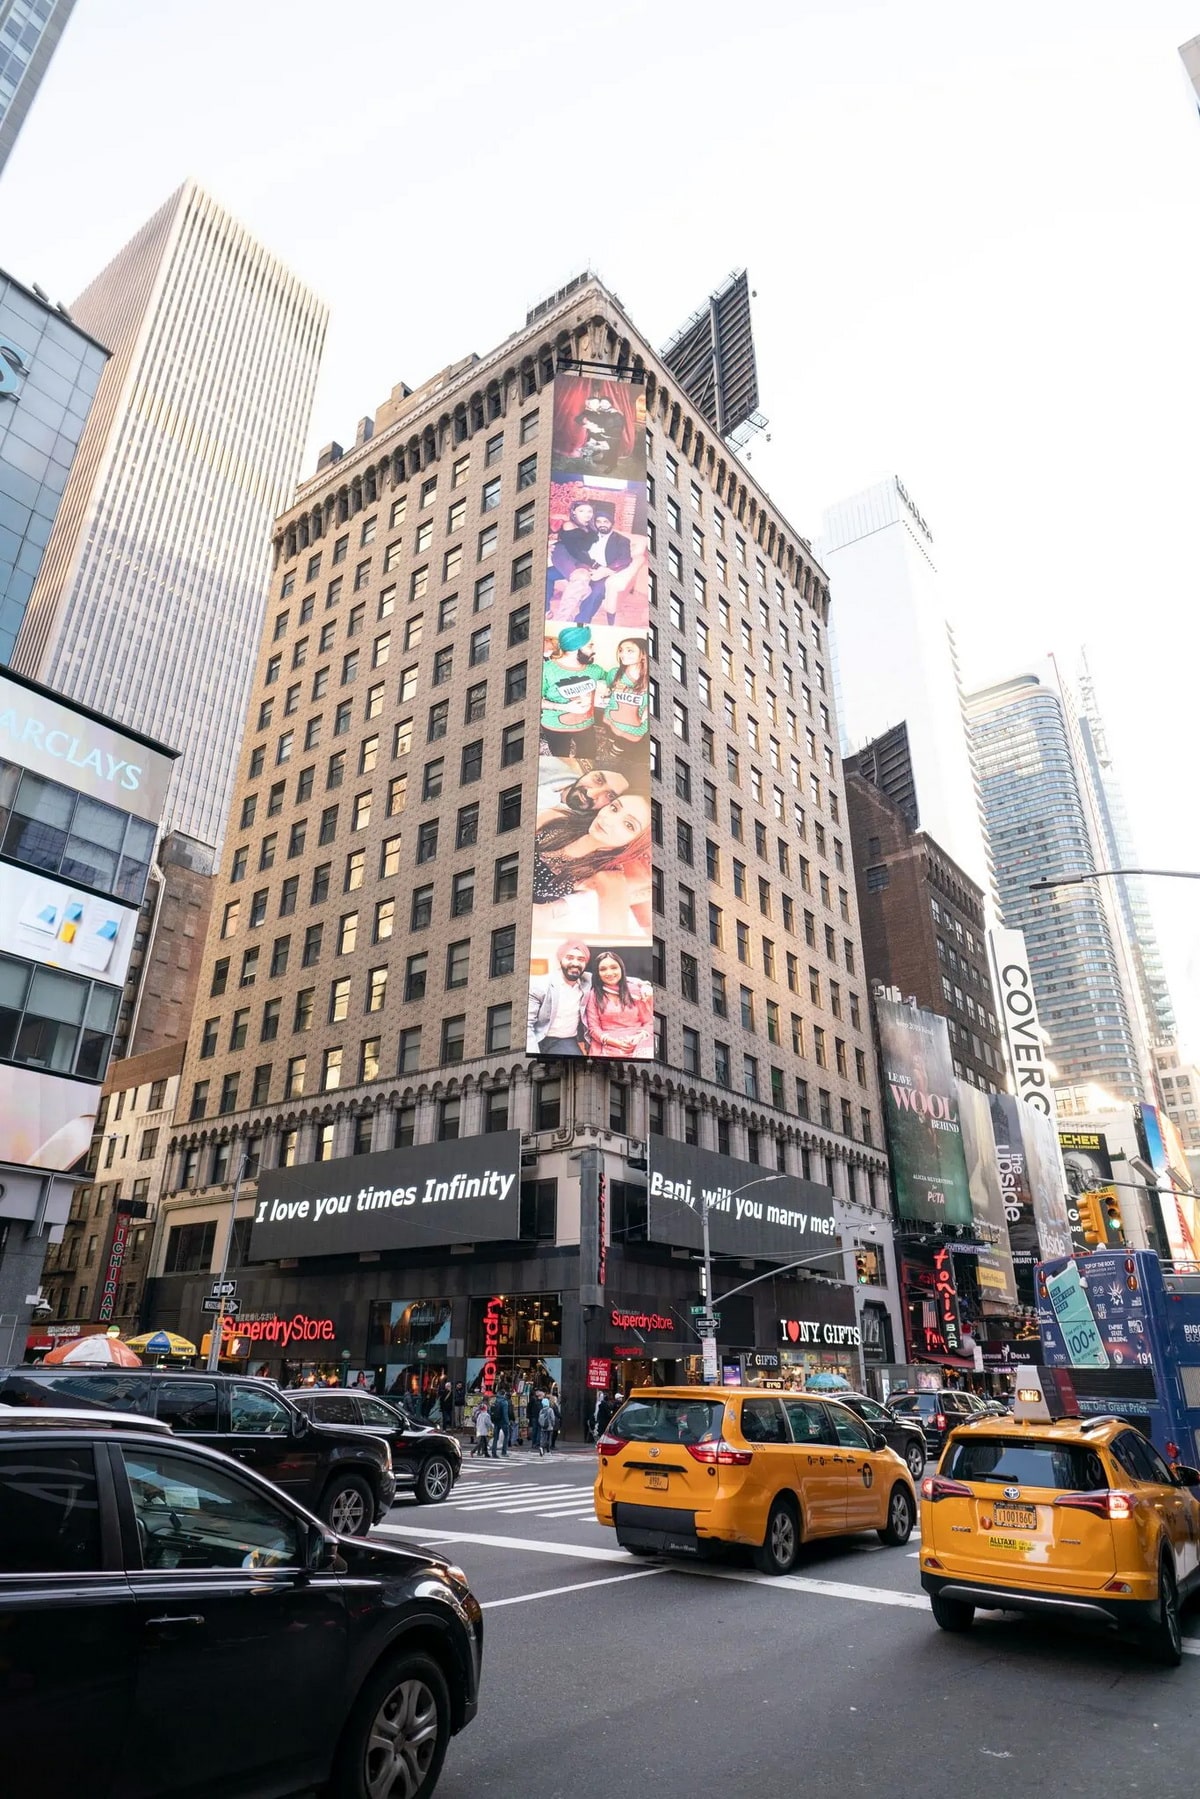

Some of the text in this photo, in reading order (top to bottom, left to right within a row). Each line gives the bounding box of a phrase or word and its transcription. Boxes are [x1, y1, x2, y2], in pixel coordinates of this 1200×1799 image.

[615, 692, 641, 704] NICE
[0, 707, 142, 790] ARCLAYS
[888, 1071, 912, 1086] LEAVE
[890, 1084, 957, 1123] WOOL
[931, 1119, 960, 1133] BEHIND
[1011, 1153, 1024, 1174] the
[255, 1170, 516, 1223] I love you times Infinity
[650, 1171, 836, 1236] Bani, will you marry me?
[99, 1229, 125, 1321] ICHIRAN
[933, 1248, 957, 1322] tonic
[780, 1320, 788, 1341] I
[823, 1323, 861, 1346] GIFTS
[945, 1323, 958, 1348] BAR
[1068, 1328, 1096, 1357] 100+
[483, 1296, 504, 1397] uperdry
[1137, 1352, 1153, 1365] 191
[755, 1354, 778, 1366] GIFTS
[1020, 1389, 1039, 1402] 7M72
[1108, 1402, 1128, 1413] Great
[1129, 1402, 1150, 1415] Price.
